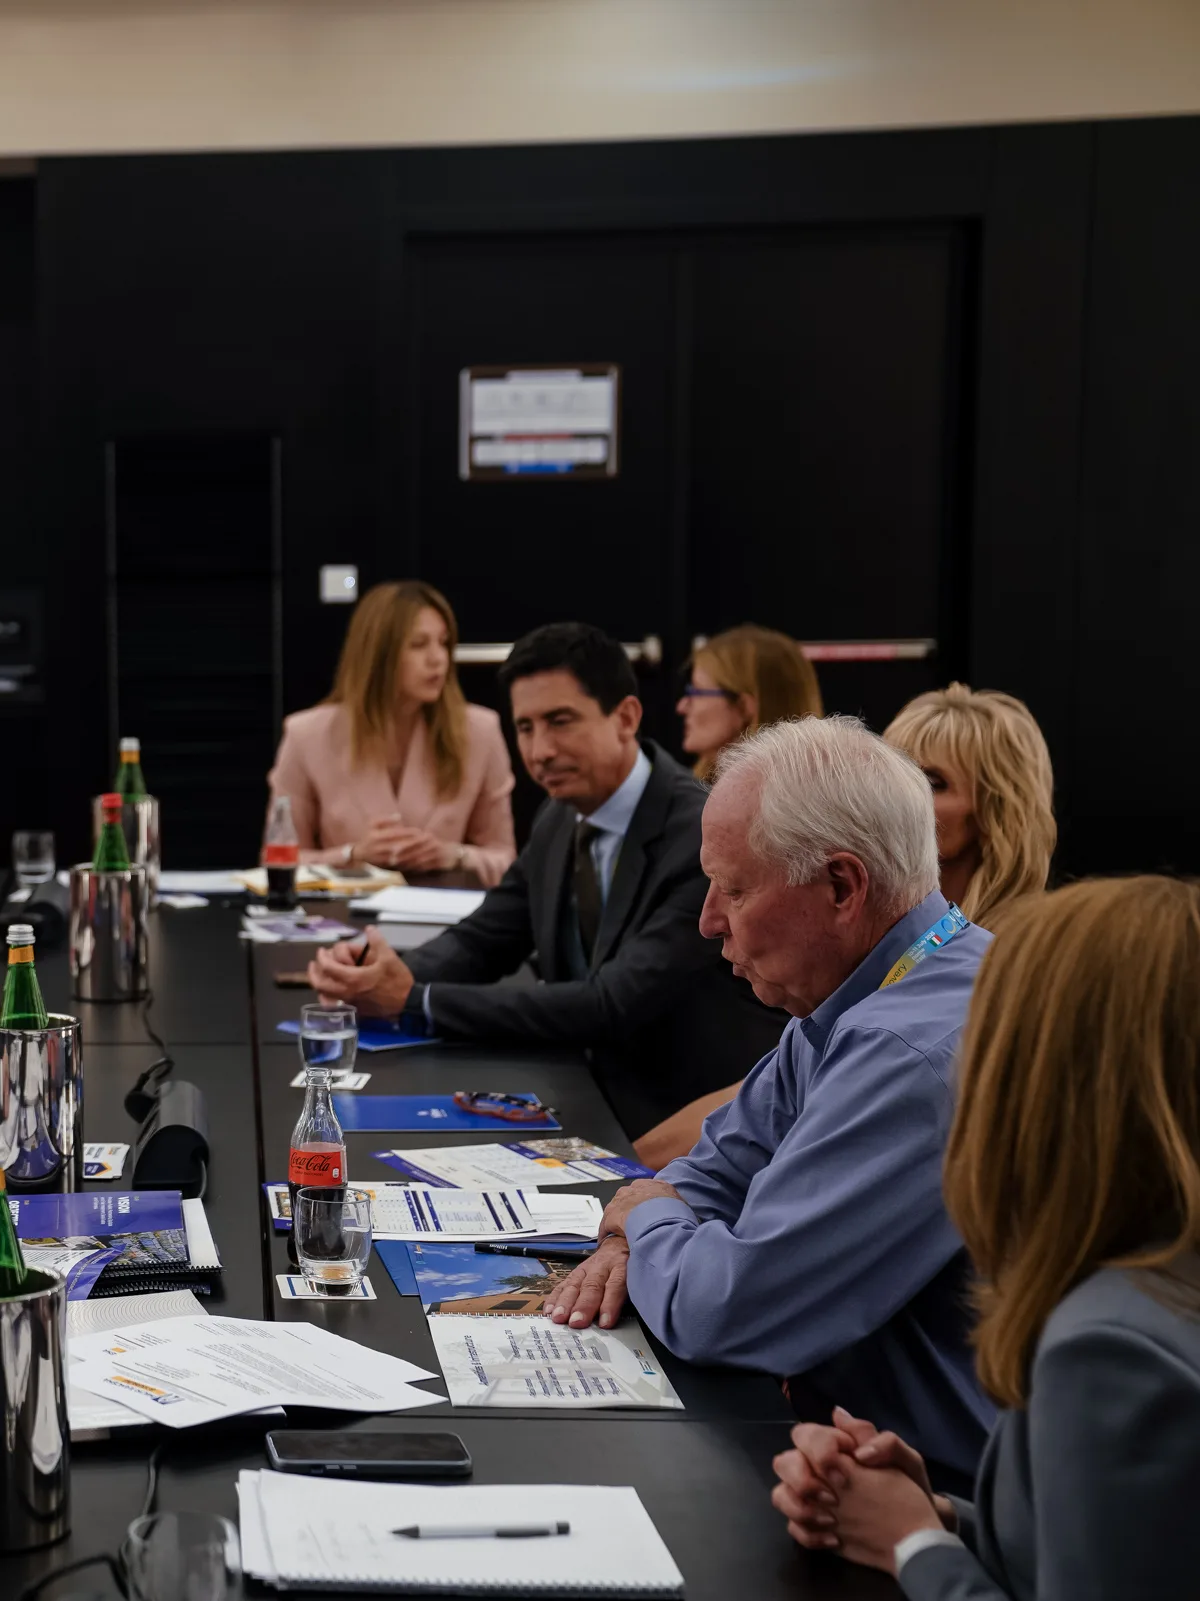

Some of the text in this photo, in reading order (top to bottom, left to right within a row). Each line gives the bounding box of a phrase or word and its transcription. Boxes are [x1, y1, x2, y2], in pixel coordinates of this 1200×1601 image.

[887, 963, 907, 987] overy
[290, 1152, 332, 1172] Coca-Cola
[118, 1196, 130, 1214] VISION
